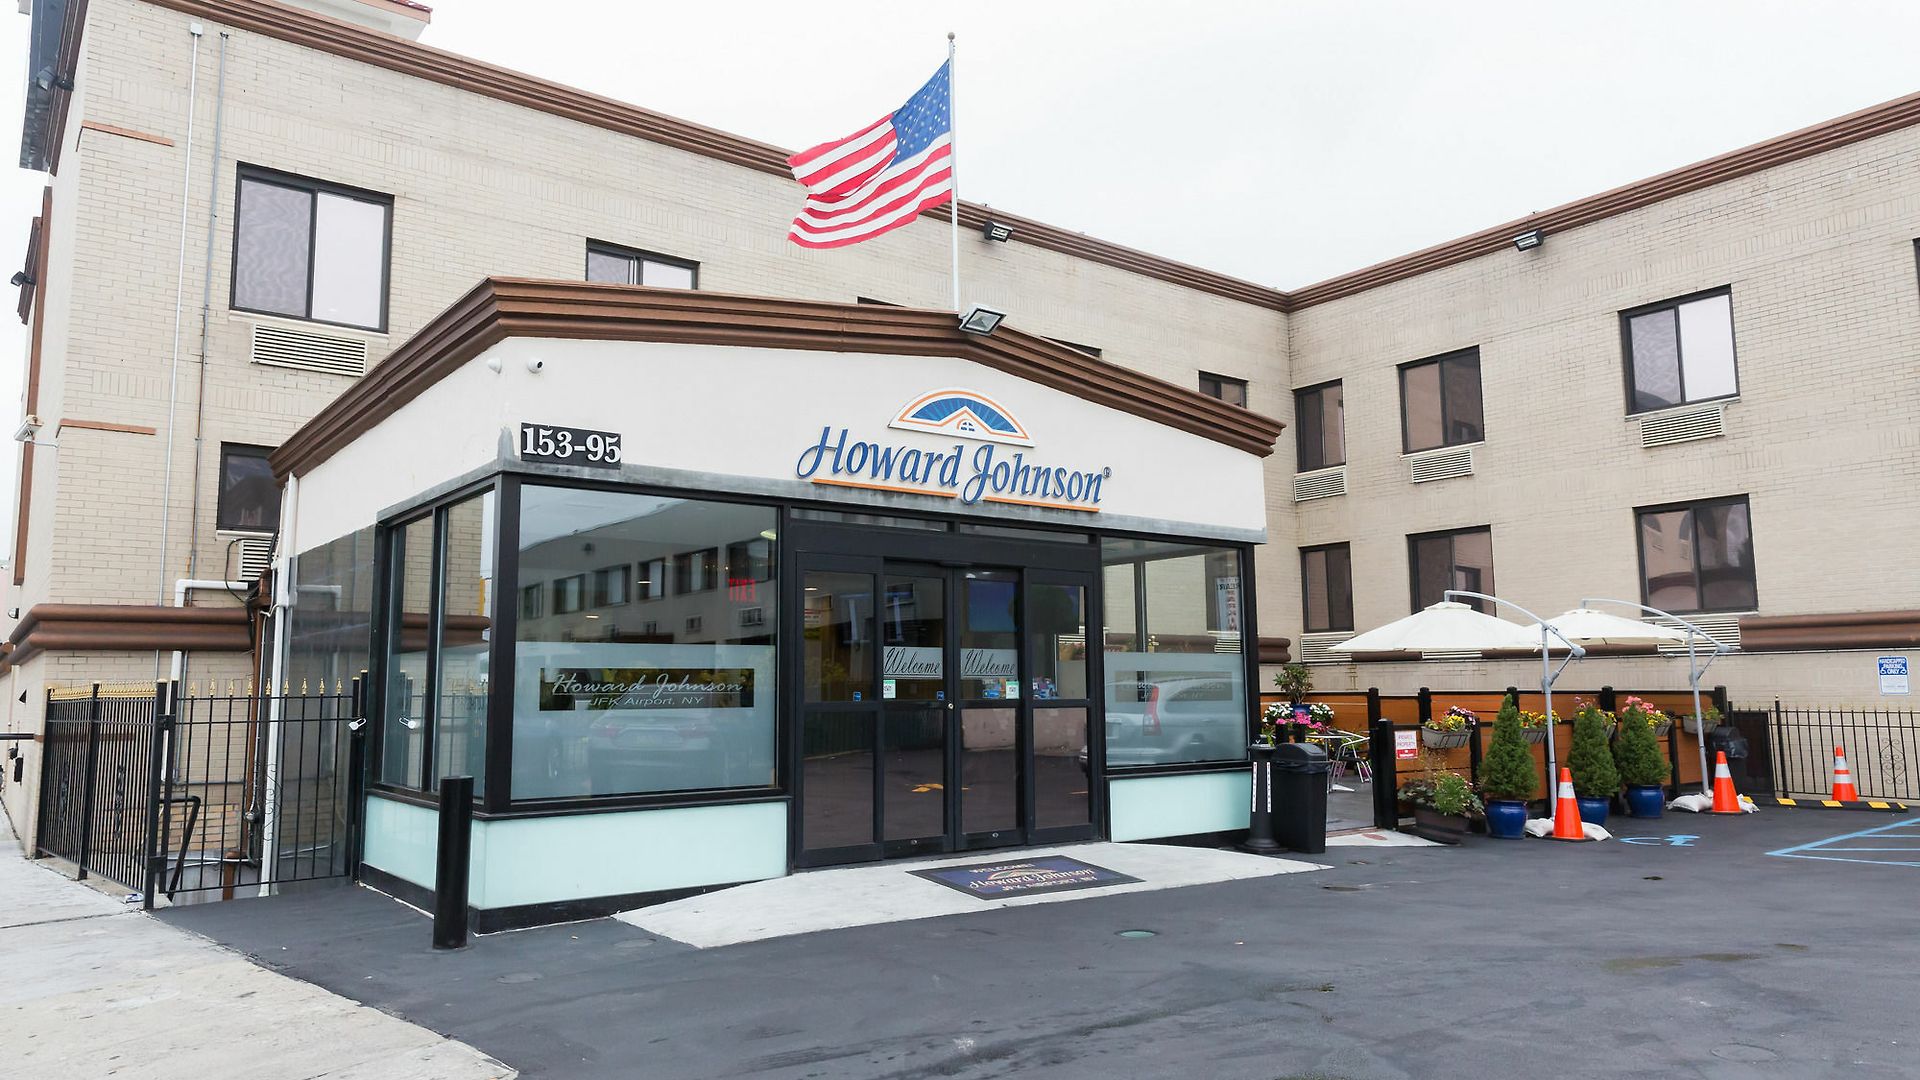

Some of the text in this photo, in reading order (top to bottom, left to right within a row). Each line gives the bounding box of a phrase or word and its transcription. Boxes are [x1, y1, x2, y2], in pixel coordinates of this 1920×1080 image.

[522, 427, 622, 463] 153-95
[797, 425, 963, 489] Howard
[884, 647, 940, 675] Welcome
[963, 649, 1015, 675] Welcome
[552, 672, 744, 700] Howard Johnson
[589, 696, 622, 706] JFK
[681, 696, 704, 705] NY
[969, 869, 1096, 889] Howard Johnson
